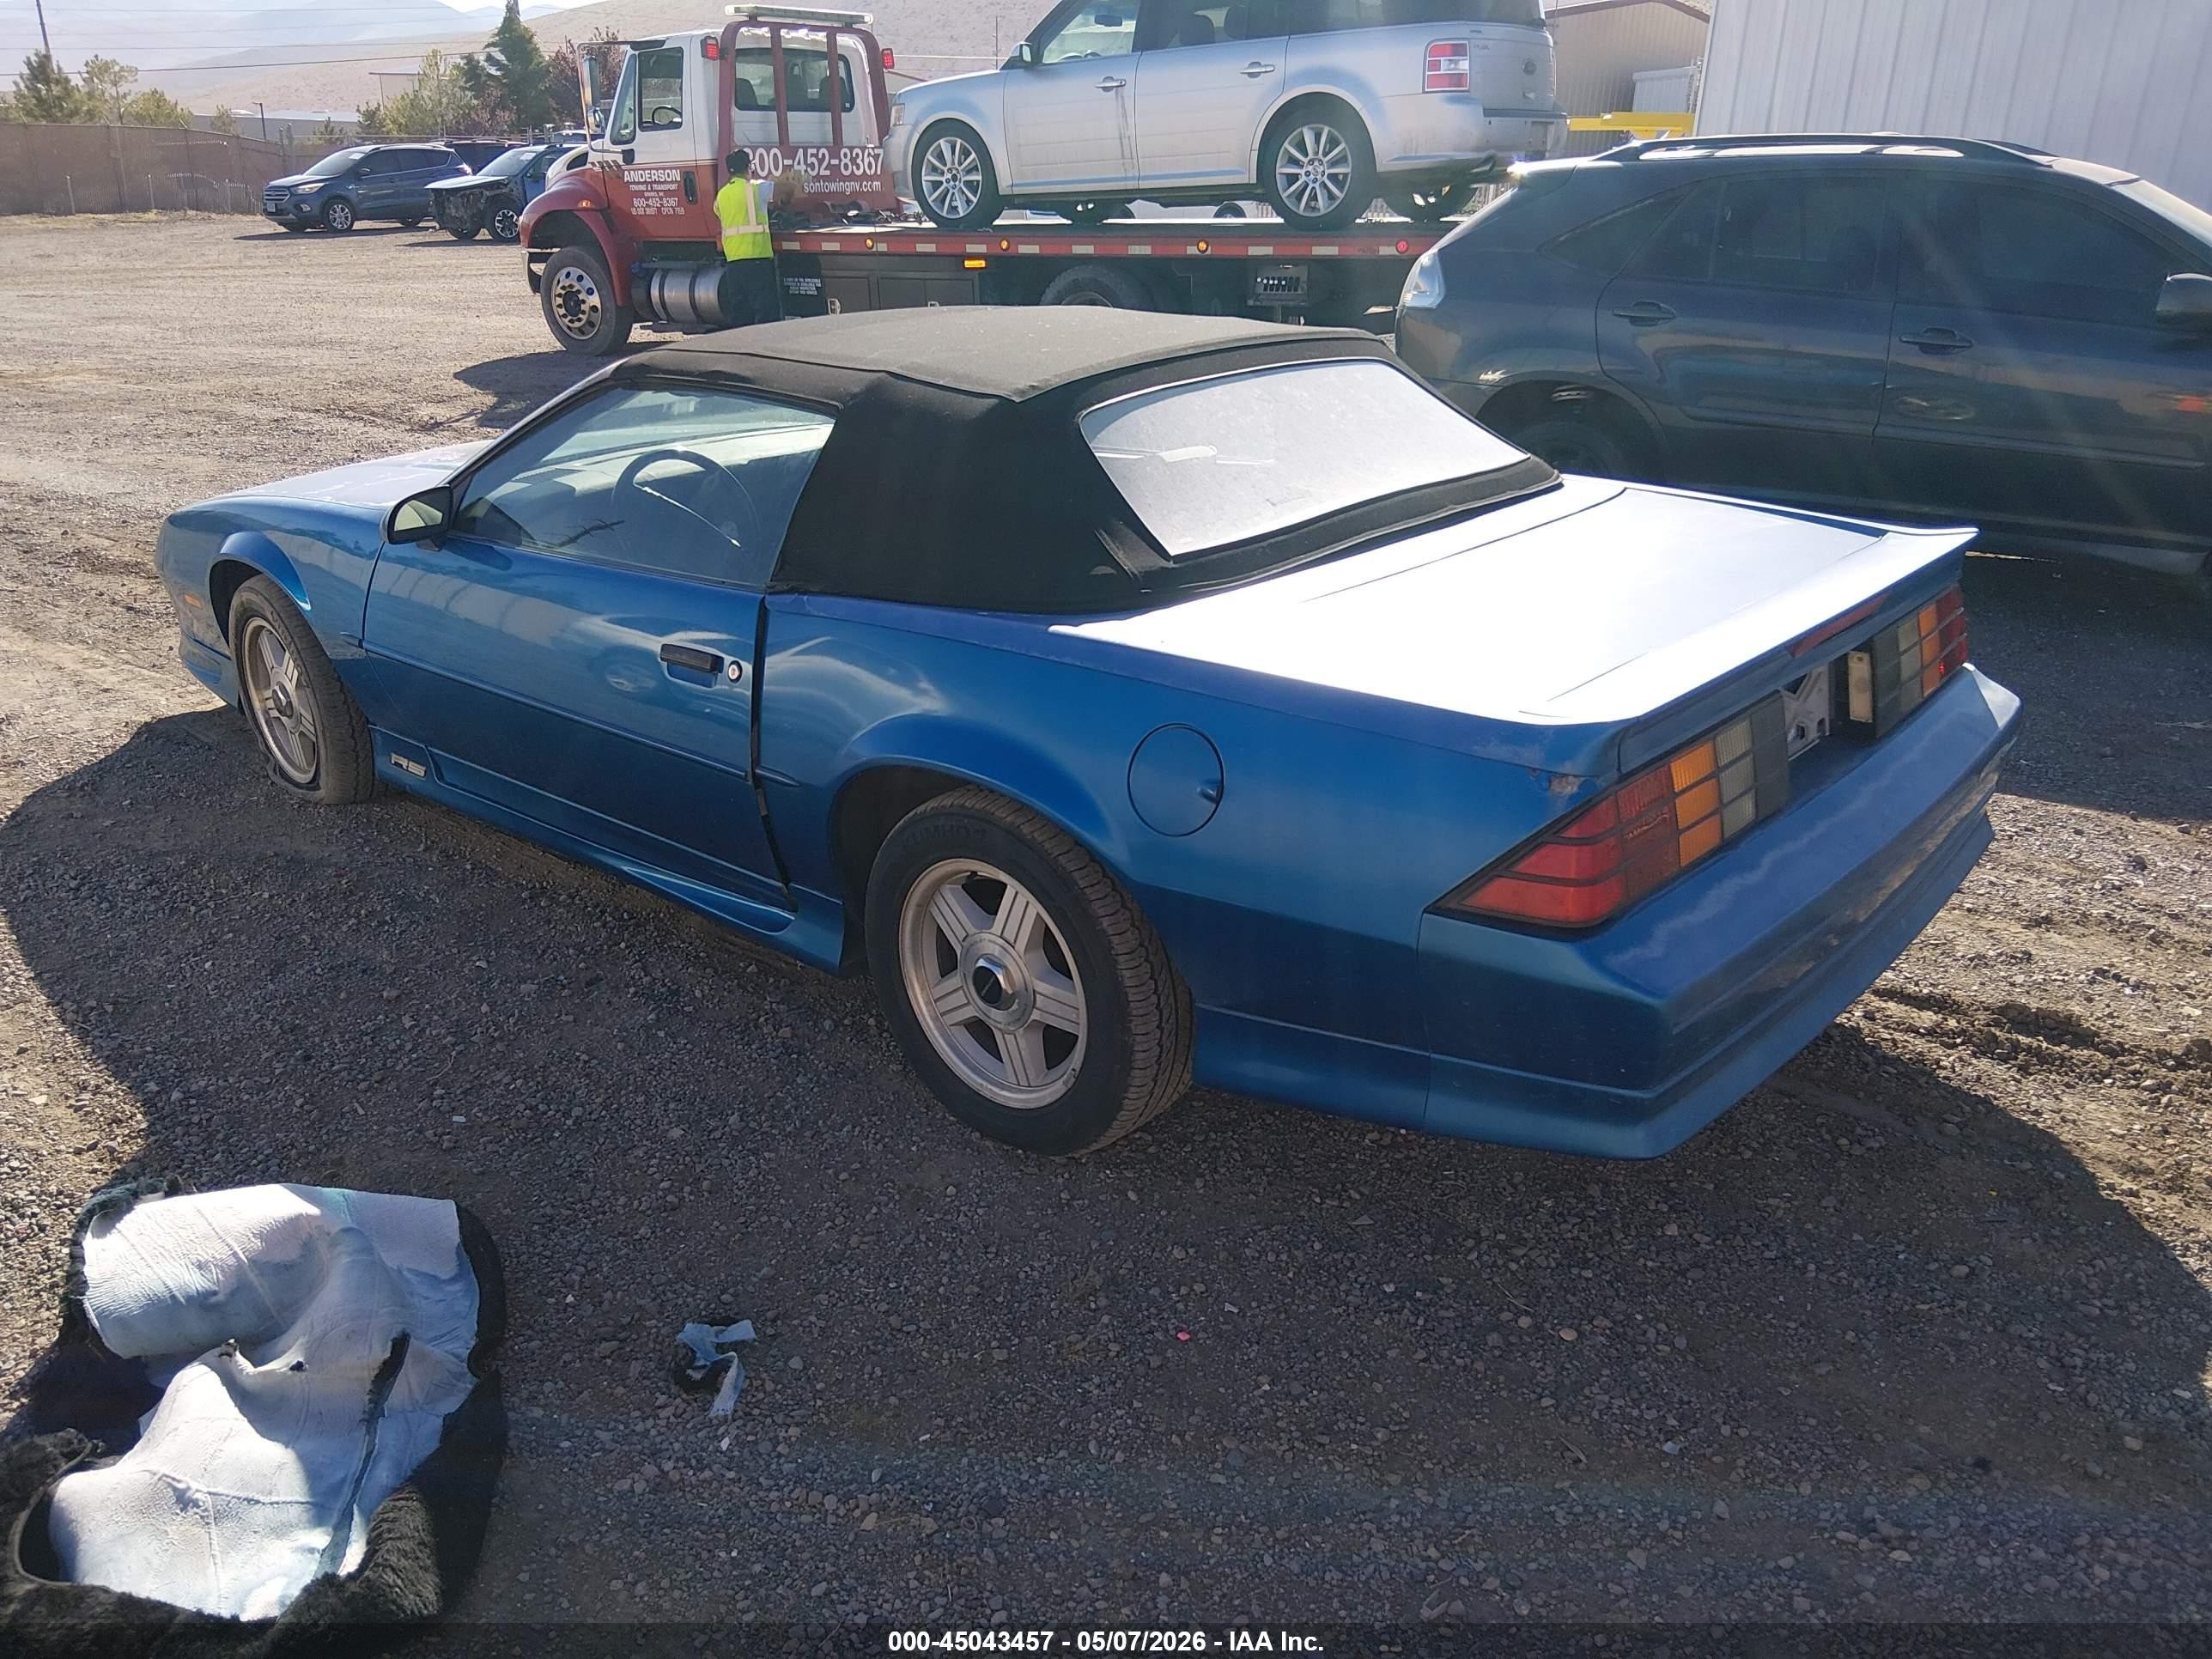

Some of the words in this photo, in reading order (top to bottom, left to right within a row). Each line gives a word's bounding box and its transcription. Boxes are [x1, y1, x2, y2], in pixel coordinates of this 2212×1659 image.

[623, 169, 681, 183] ANDERSON
[804, 178, 882, 196] sontowingnv.com
[633, 197, 678, 207] 800-452-8367
